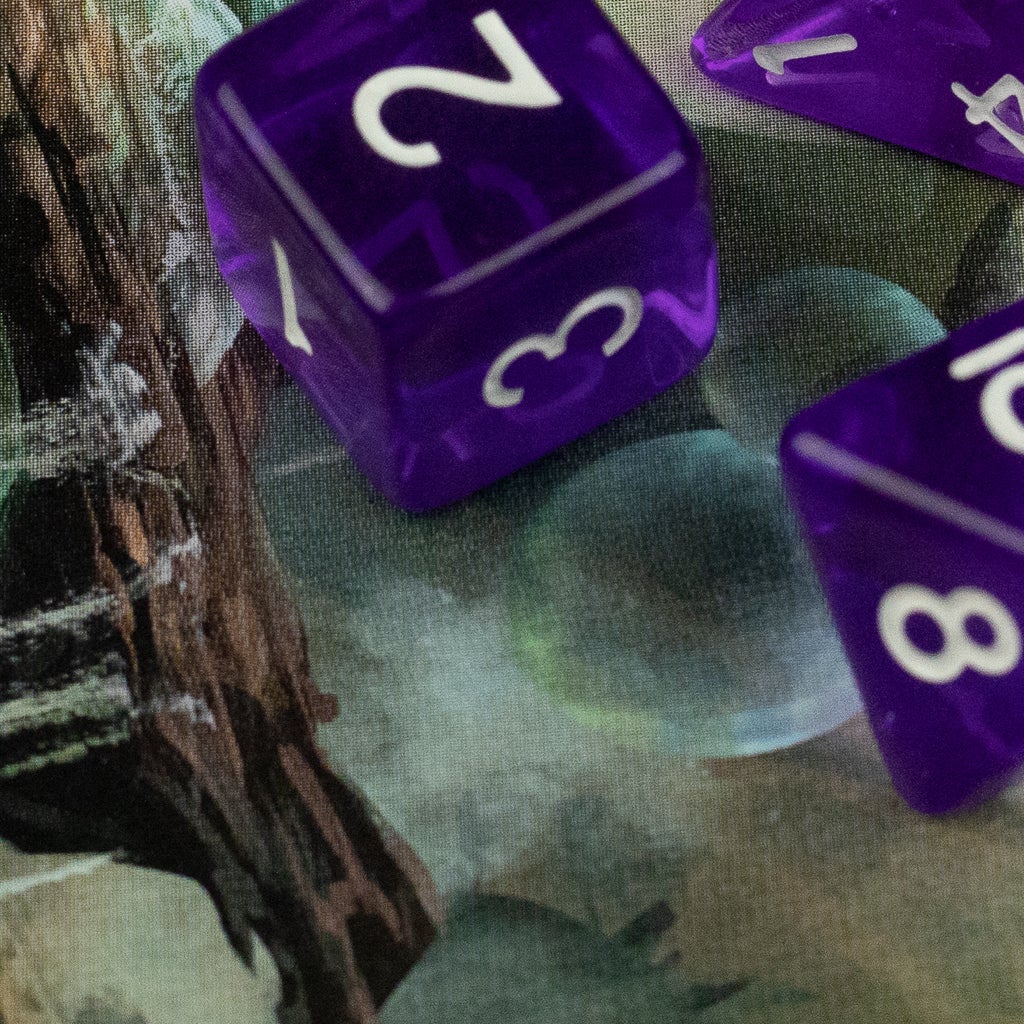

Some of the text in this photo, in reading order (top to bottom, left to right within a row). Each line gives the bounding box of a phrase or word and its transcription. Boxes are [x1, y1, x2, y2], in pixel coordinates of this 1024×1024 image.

[352, 9, 563, 169] 2
[753, 33, 857, 75] 1
[482, 286, 643, 408] 3
[876, 583, 1023, 684] 8
